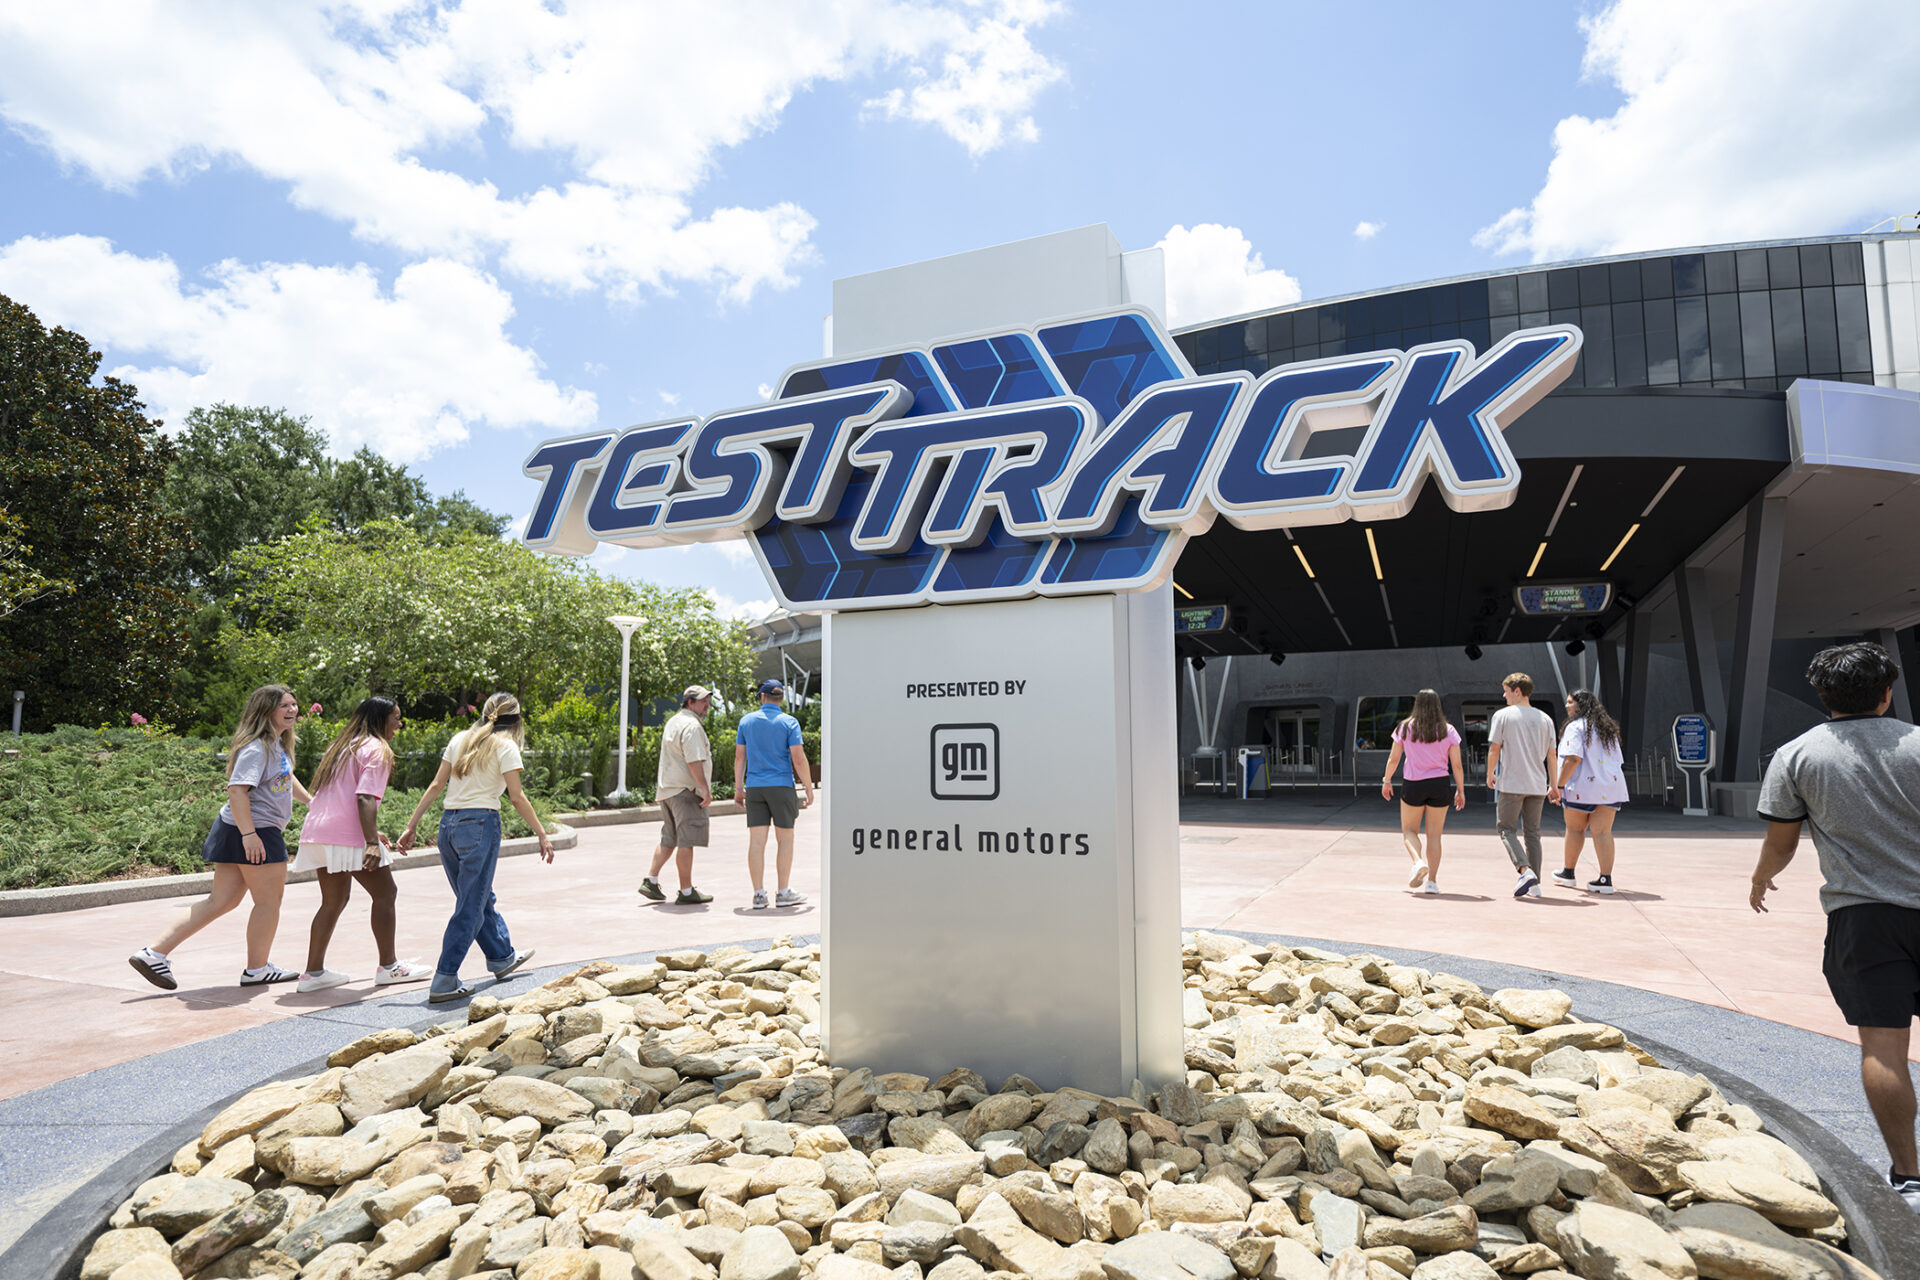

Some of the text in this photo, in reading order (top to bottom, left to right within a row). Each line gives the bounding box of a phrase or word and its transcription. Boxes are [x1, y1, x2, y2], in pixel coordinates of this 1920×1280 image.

[525, 330, 1573, 545] TEST TRACK
[1544, 588, 1581, 596] STANDBY
[1181, 609, 1212, 617] LIGHTNING
[906, 680, 1026, 698] PRESENTED BY
[942, 743, 987, 781] gm
[852, 824, 1089, 856] general motors
